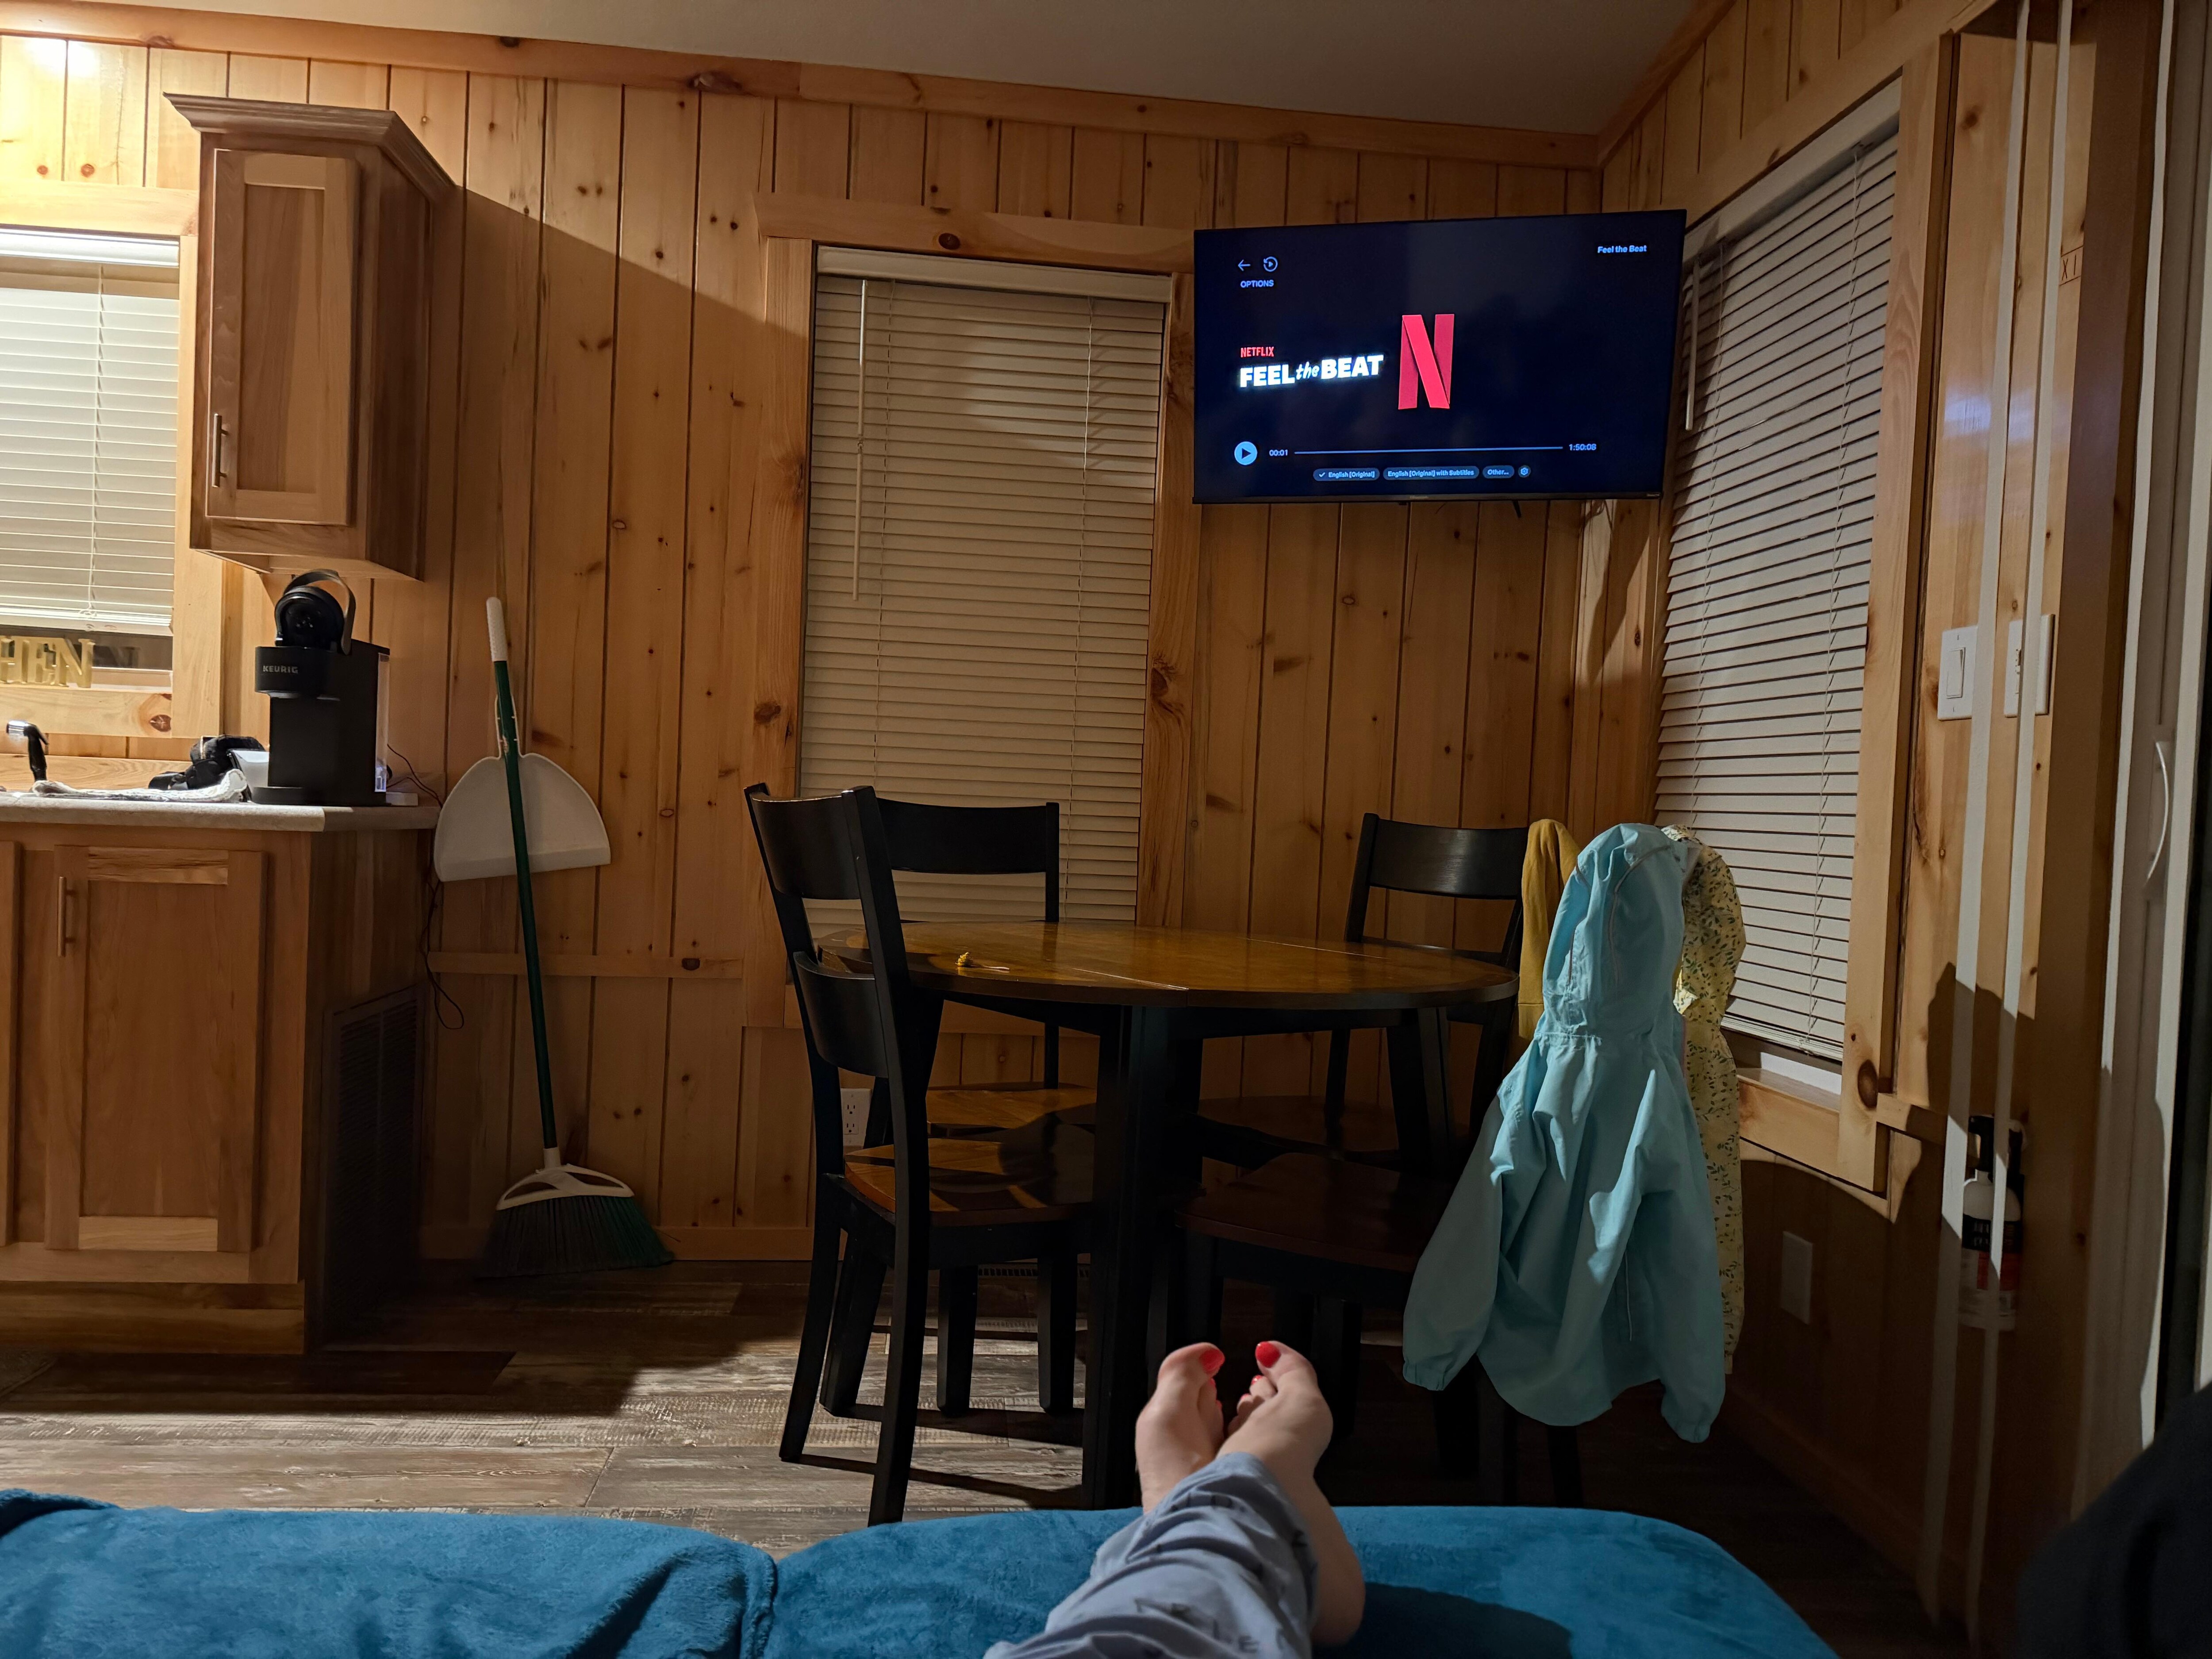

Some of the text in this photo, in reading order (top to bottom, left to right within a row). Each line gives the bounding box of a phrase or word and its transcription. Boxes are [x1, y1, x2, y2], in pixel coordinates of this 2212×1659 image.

[1240, 280, 1274, 288] OPTIONS
[1240, 346, 1274, 357] NETFLIX
[1398, 314, 1455, 410] N
[1240, 354, 1384, 388] FEEL the BEAT
[263, 665, 298, 674] KEURIG
